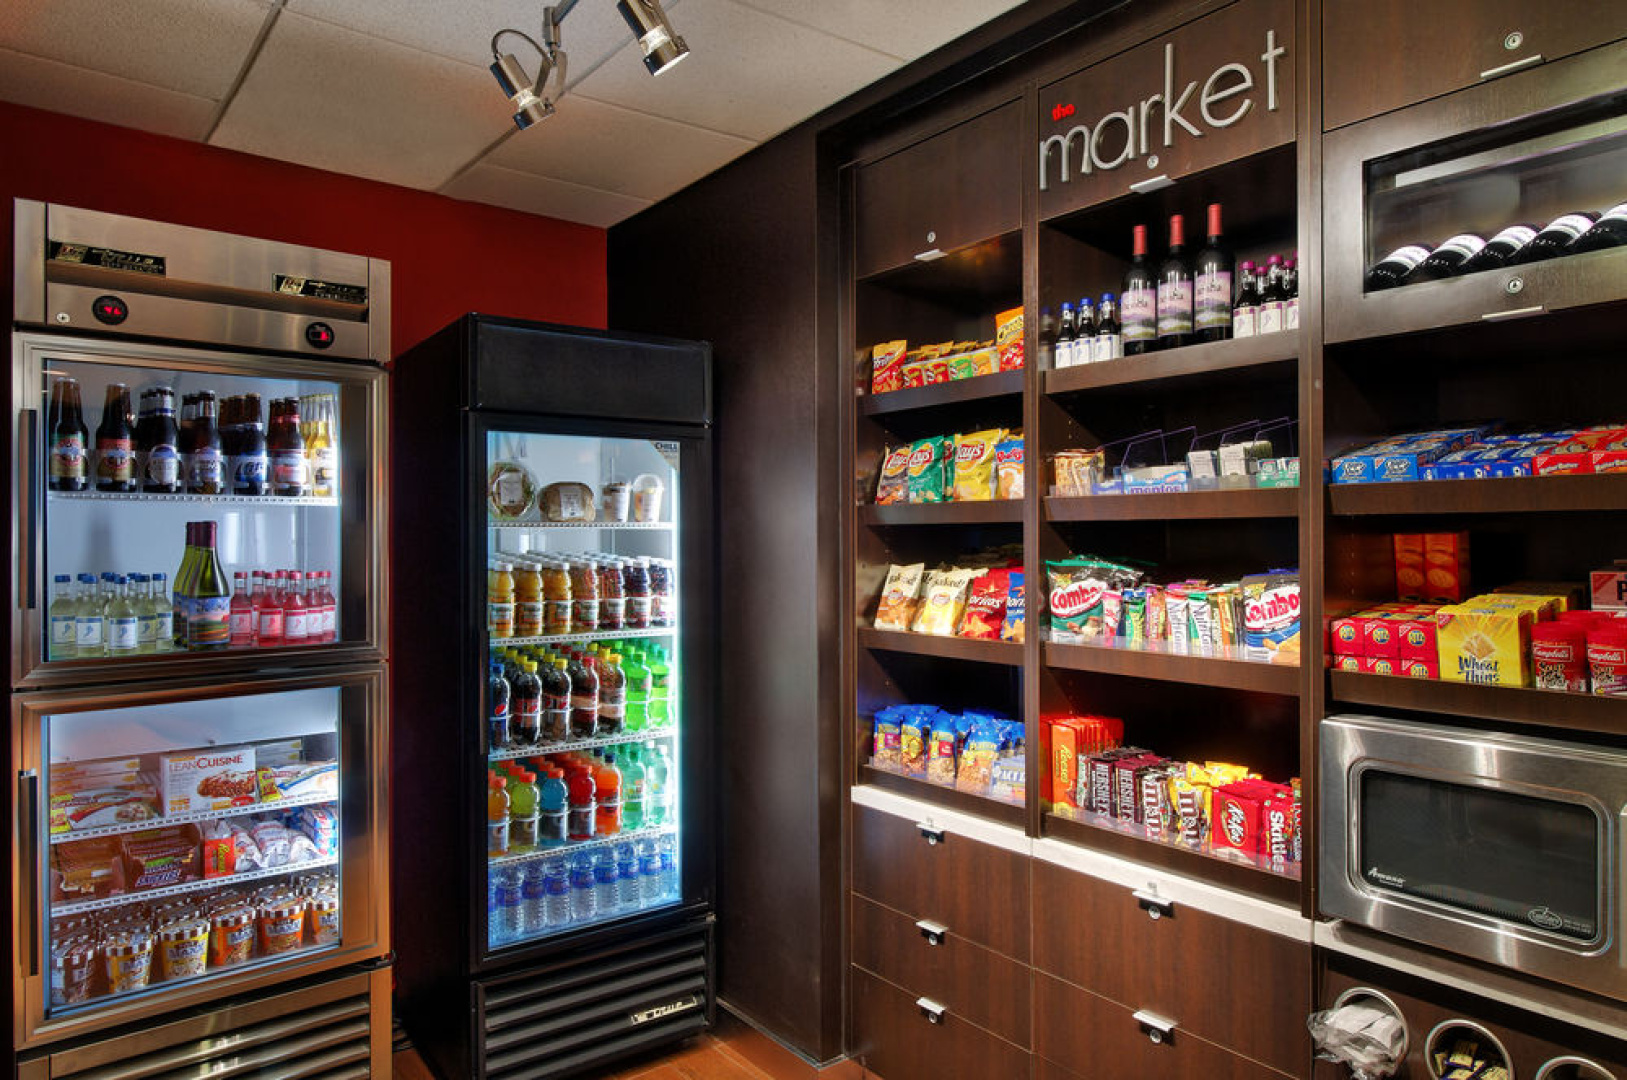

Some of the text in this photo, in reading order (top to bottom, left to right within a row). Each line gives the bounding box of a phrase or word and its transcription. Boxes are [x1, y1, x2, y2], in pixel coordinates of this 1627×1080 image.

[1039, 30, 1286, 191] market
[1052, 103, 1076, 121] the
[1246, 590, 1300, 622] Combo
[1458, 655, 1499, 672] Wheat
[169, 755, 243, 772] LEAN CUISINE
[1270, 809, 1288, 873] Skittles
